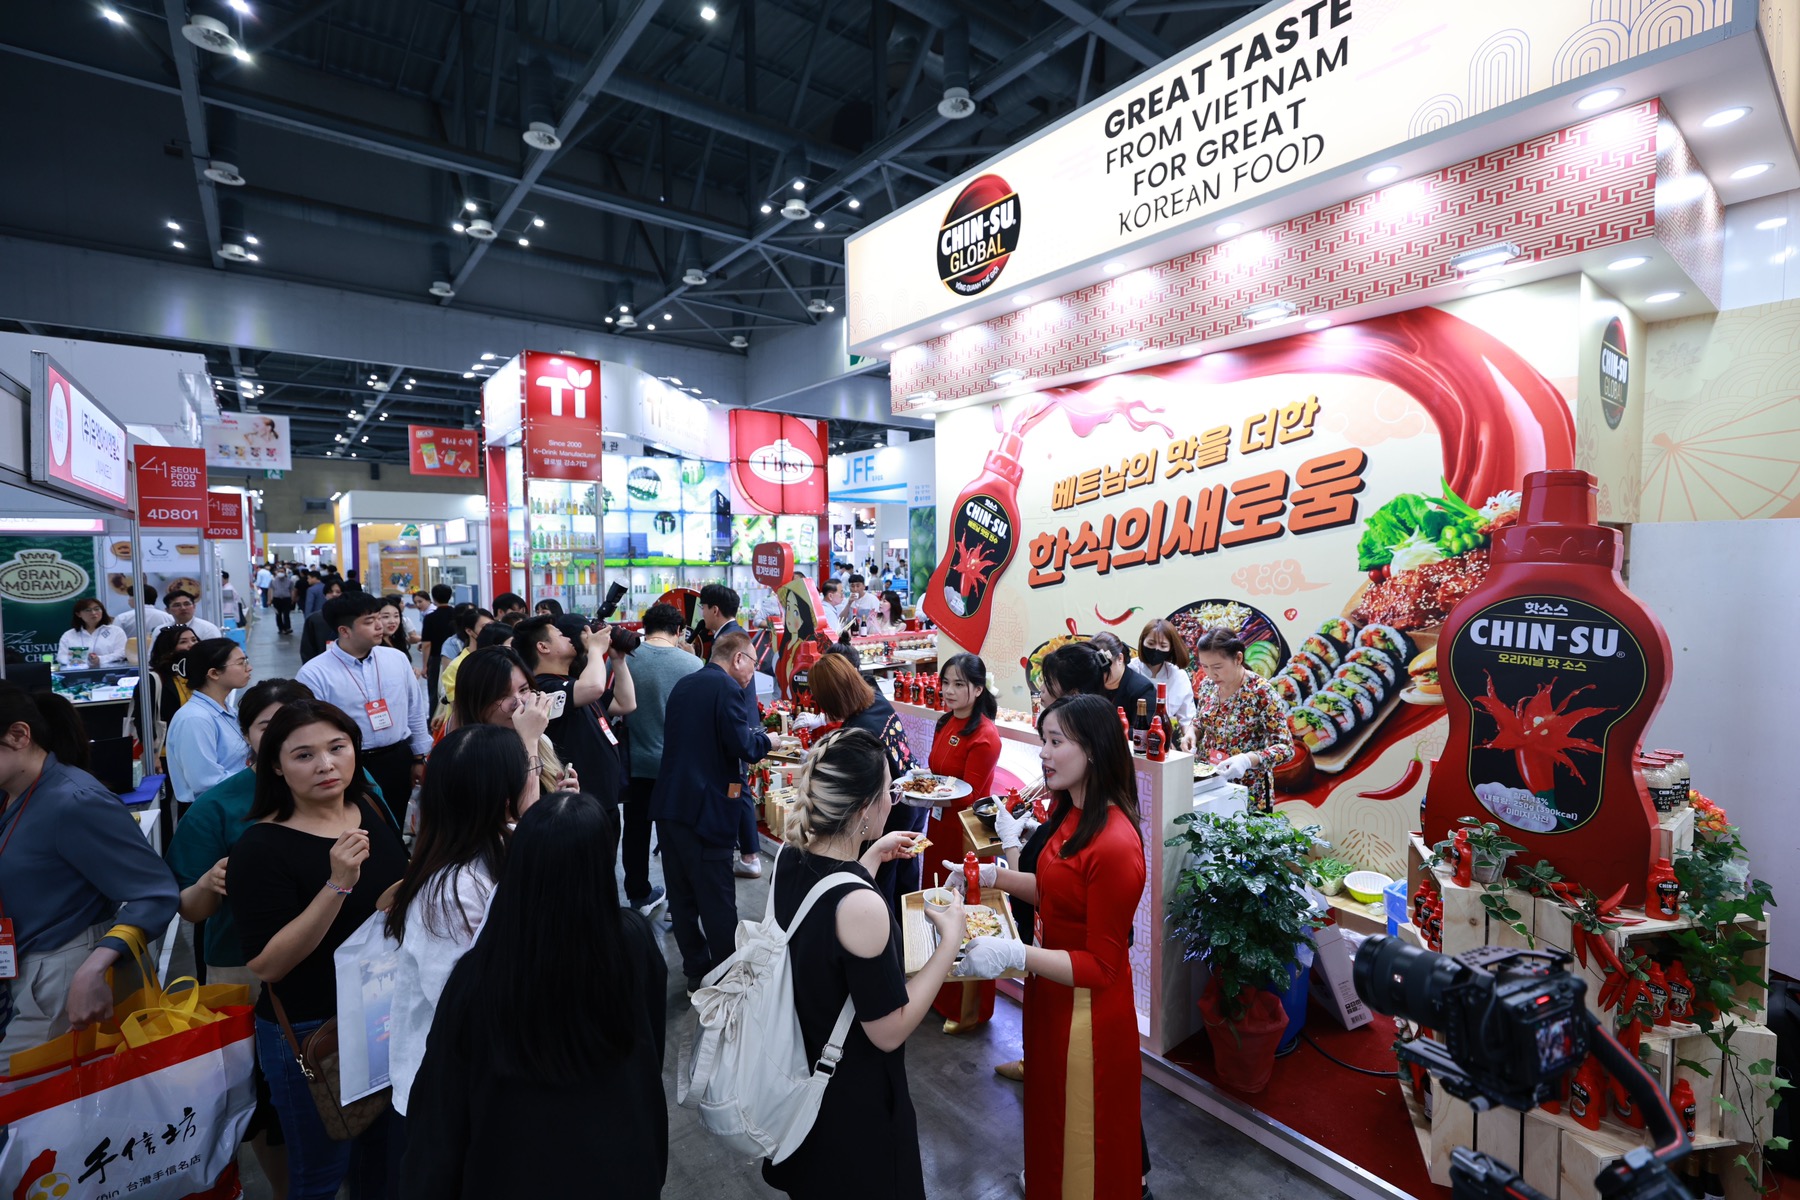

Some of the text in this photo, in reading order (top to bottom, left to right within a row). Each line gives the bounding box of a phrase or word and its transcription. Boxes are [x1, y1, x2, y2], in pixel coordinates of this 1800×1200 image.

[1104, 0, 1352, 138] GREAT TASTE
[1106, 35, 1348, 174] FROM VIETNAM
[1134, 97, 1306, 196] FOR GREAT
[1118, 133, 1325, 235] KOREAN FOOD
[941, 199, 1015, 256] CHIN-SU
[950, 233, 1006, 273] GLOBAL
[1602, 348, 1627, 384] CHIN-SU
[1603, 376, 1623, 402] GLOBAL
[548, 439, 565, 447] Since
[1051, 394, 1321, 511] 베트남의 맛을 더한
[544, 458, 588, 467] 글로벌 강소기업
[559, 450, 597, 458] Manufacturer
[759, 452, 807, 474] T'best
[170, 466, 201, 474] SEOUL
[170, 473, 197, 481] FOOD
[842, 454, 875, 485] JFF
[171, 480, 196, 488] 2023
[147, 508, 199, 521] 4D801
[966, 501, 1008, 537] CHIN-SU
[17, 569, 60, 580] GRAN
[5, 579, 74, 592] MORAVIA
[1524, 601, 1569, 617] 핫소스
[19, 643, 59, 653] SUSTAI
[1469, 618, 1620, 657] CHIN-SU
[1498, 653, 1587, 672] 오리지널 핫 소스
[1513, 800, 1535, 812] 250g
[1536, 805, 1578, 820] (390kcal)
[1532, 796, 1549, 806] 13%
[1506, 808, 1549, 824] 이미지 사진
[77, 1106, 196, 1184] 手信坊
[126, 1153, 202, 1192] 台灣手信名店
